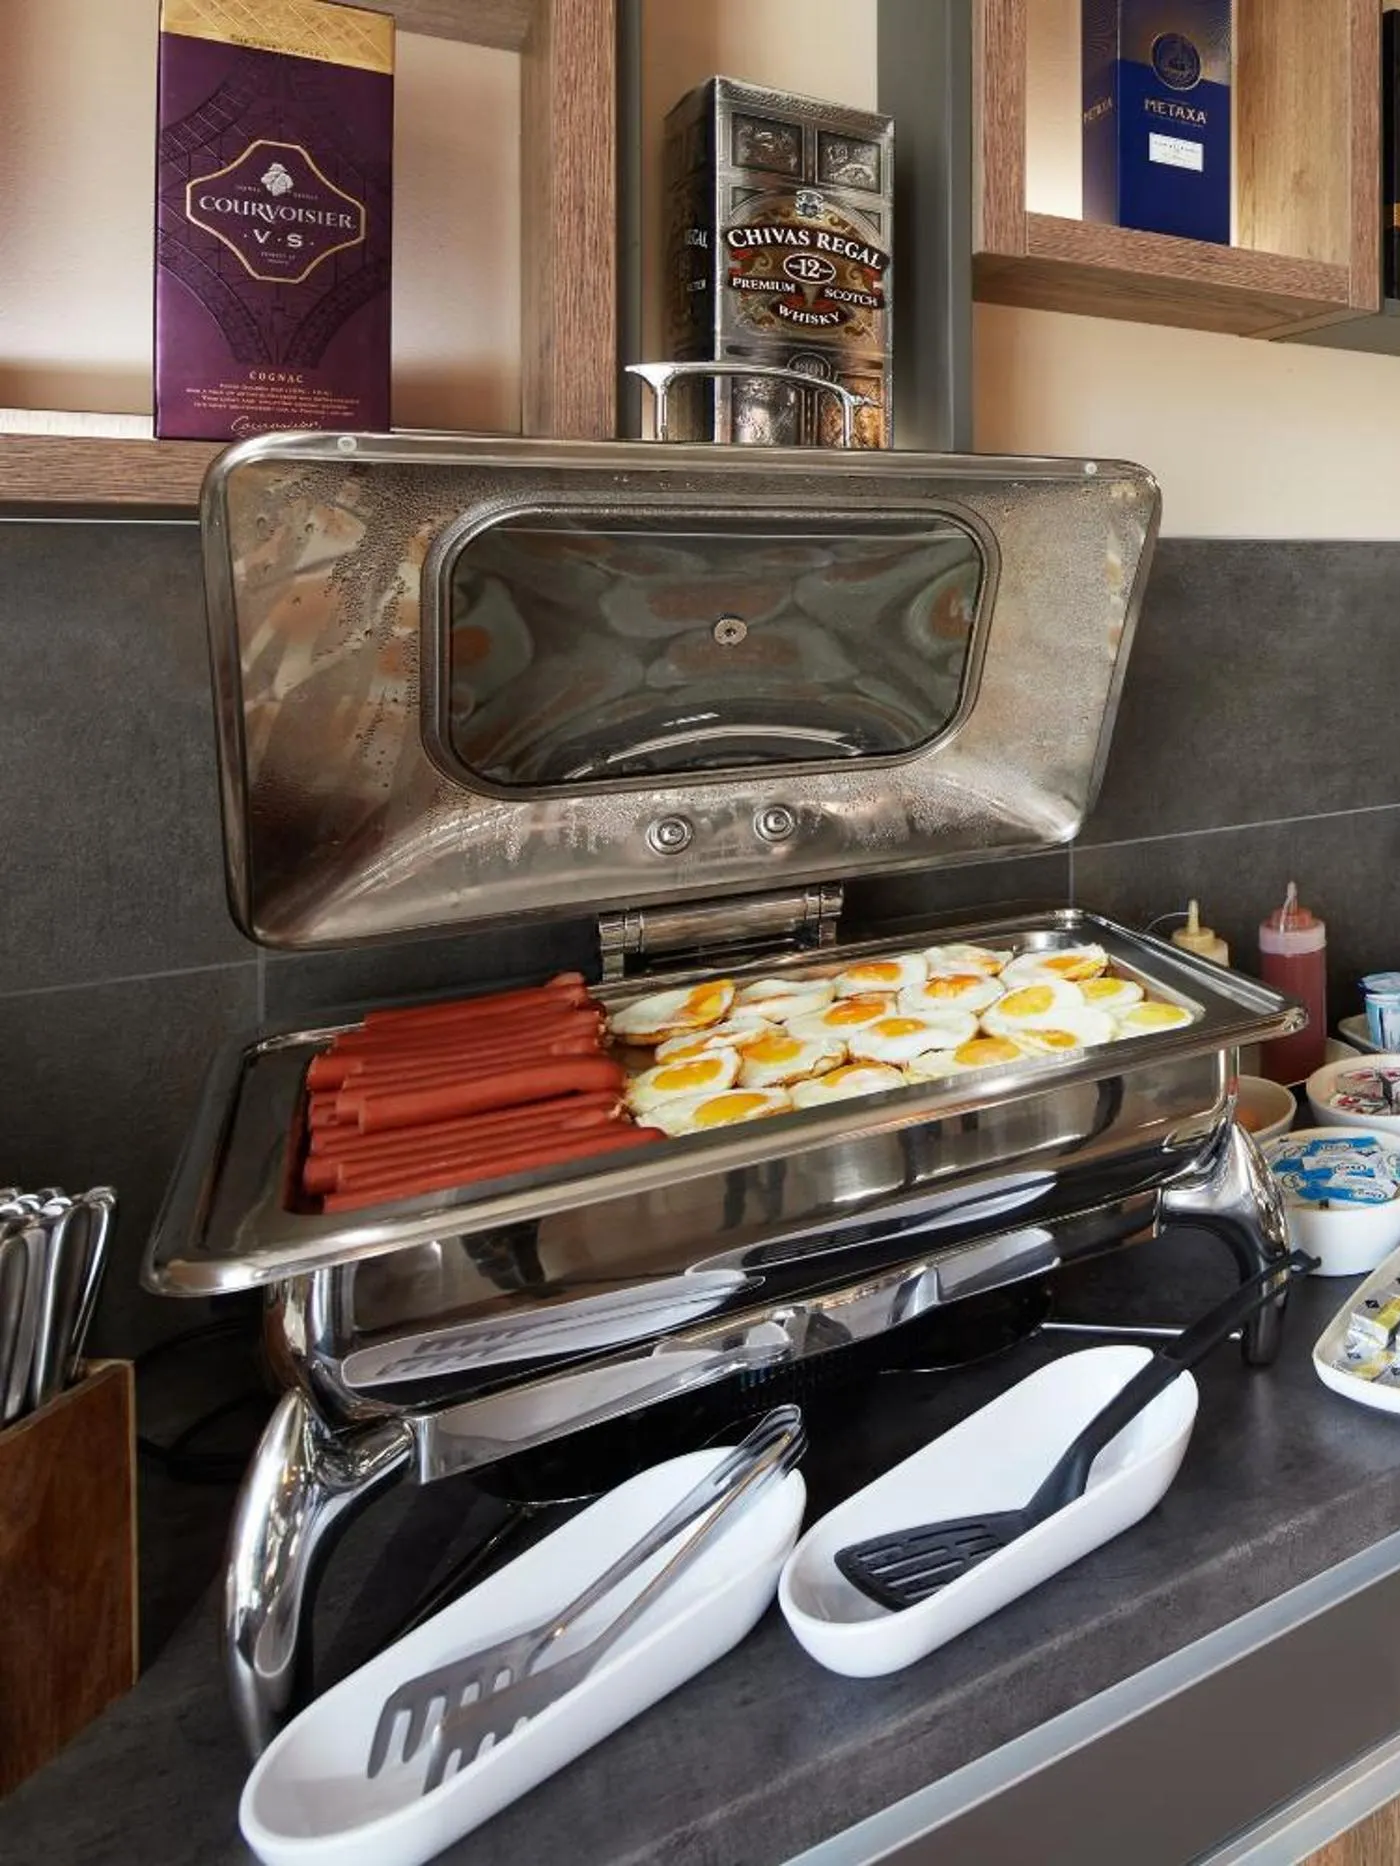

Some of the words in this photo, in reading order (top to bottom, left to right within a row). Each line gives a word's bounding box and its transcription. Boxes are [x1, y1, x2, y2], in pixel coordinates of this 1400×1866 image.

[1144, 98, 1206, 125] METAXA
[200, 195, 354, 229] COURVOISIER
[727, 227, 811, 248] CHIVAS
[816, 231, 882, 270] REGAL
[798, 258, 821, 279] 12
[732, 277, 796, 293] PREMIUM
[824, 288, 878, 307] SCOTCH
[779, 304, 841, 325] WHISKY
[249, 372, 304, 384] COGNAC
